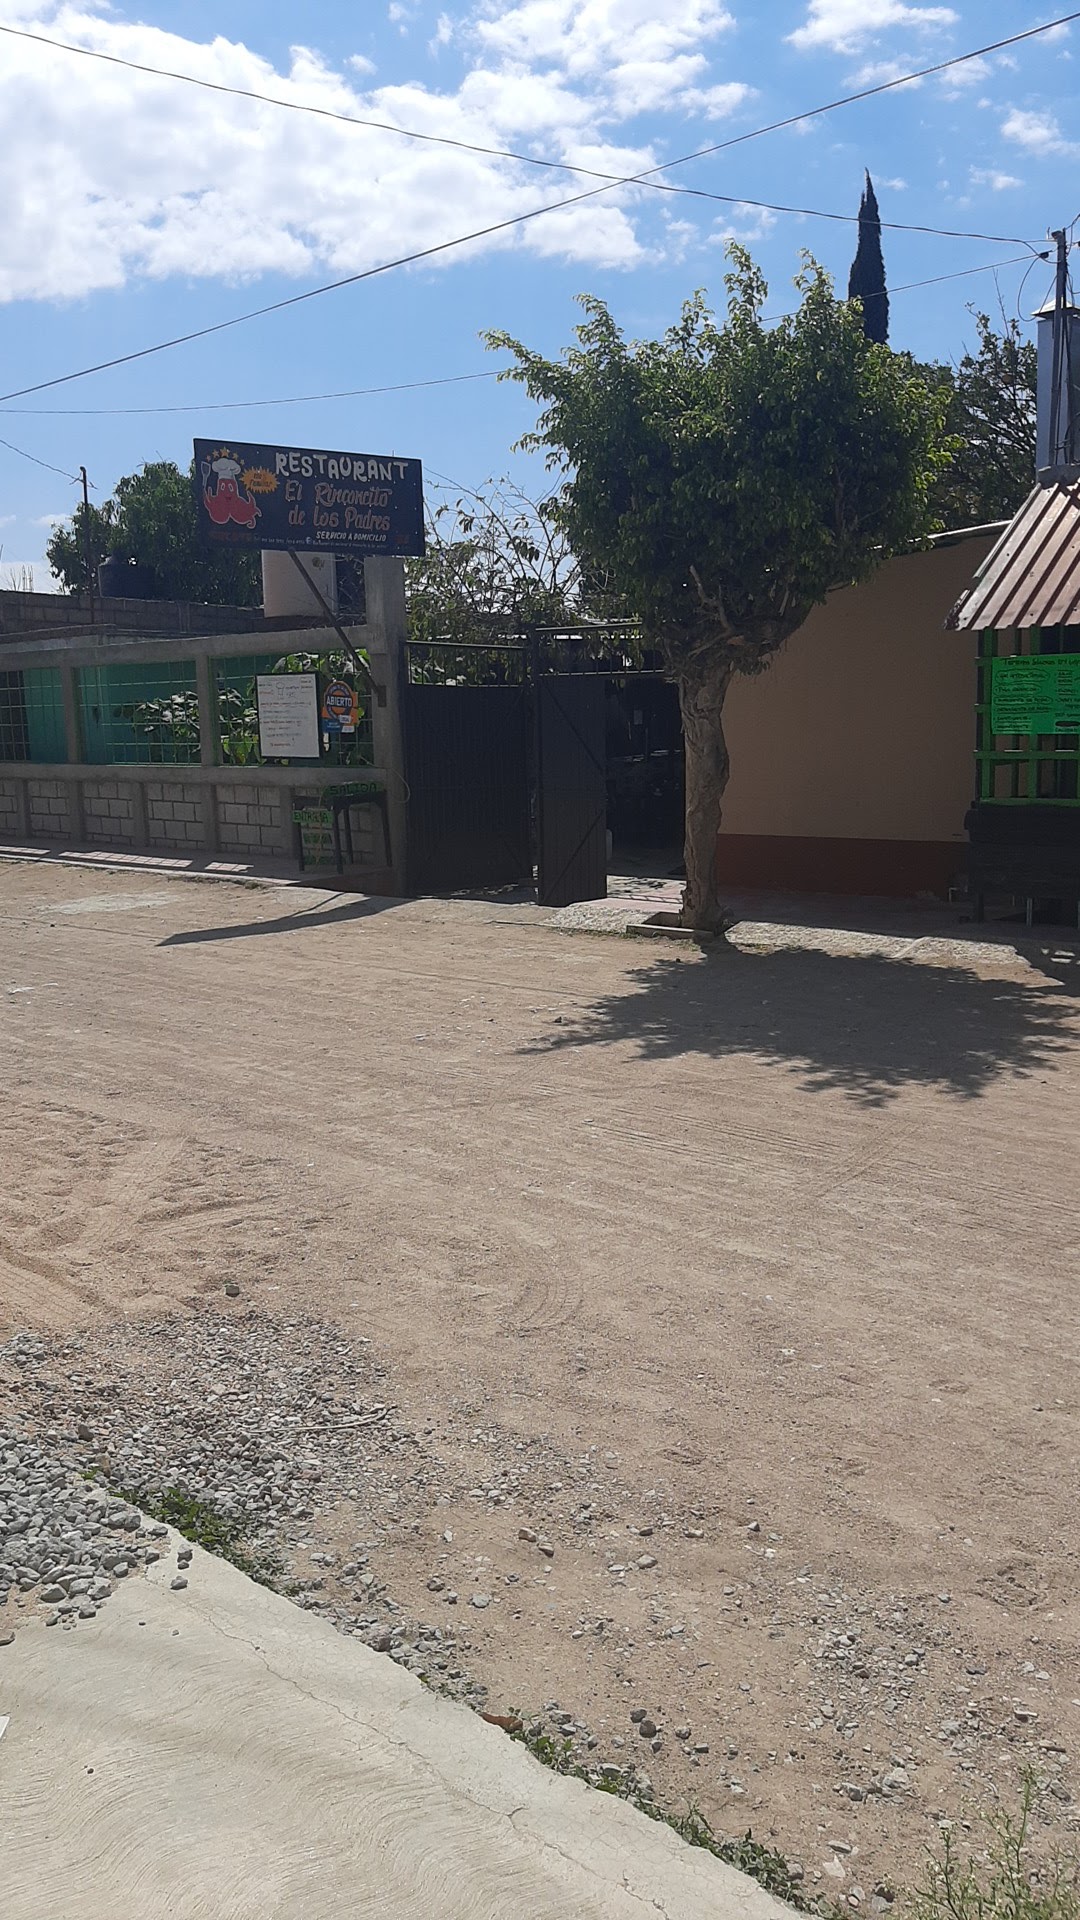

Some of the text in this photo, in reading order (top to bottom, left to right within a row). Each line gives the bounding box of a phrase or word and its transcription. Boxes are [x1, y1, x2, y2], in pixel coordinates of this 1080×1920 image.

[275, 452, 409, 482] RESTAURANT
[285, 480, 392, 508] El Rinconcito
[288, 505, 391, 532] de los Padres
[316, 531, 347, 540] SERVICIO
[348, 533, 353, 541] A
[353, 533, 387, 542] DOMICILIO
[326, 695, 352, 707] ABIERTO
[330, 782, 377, 795] SALIDA
